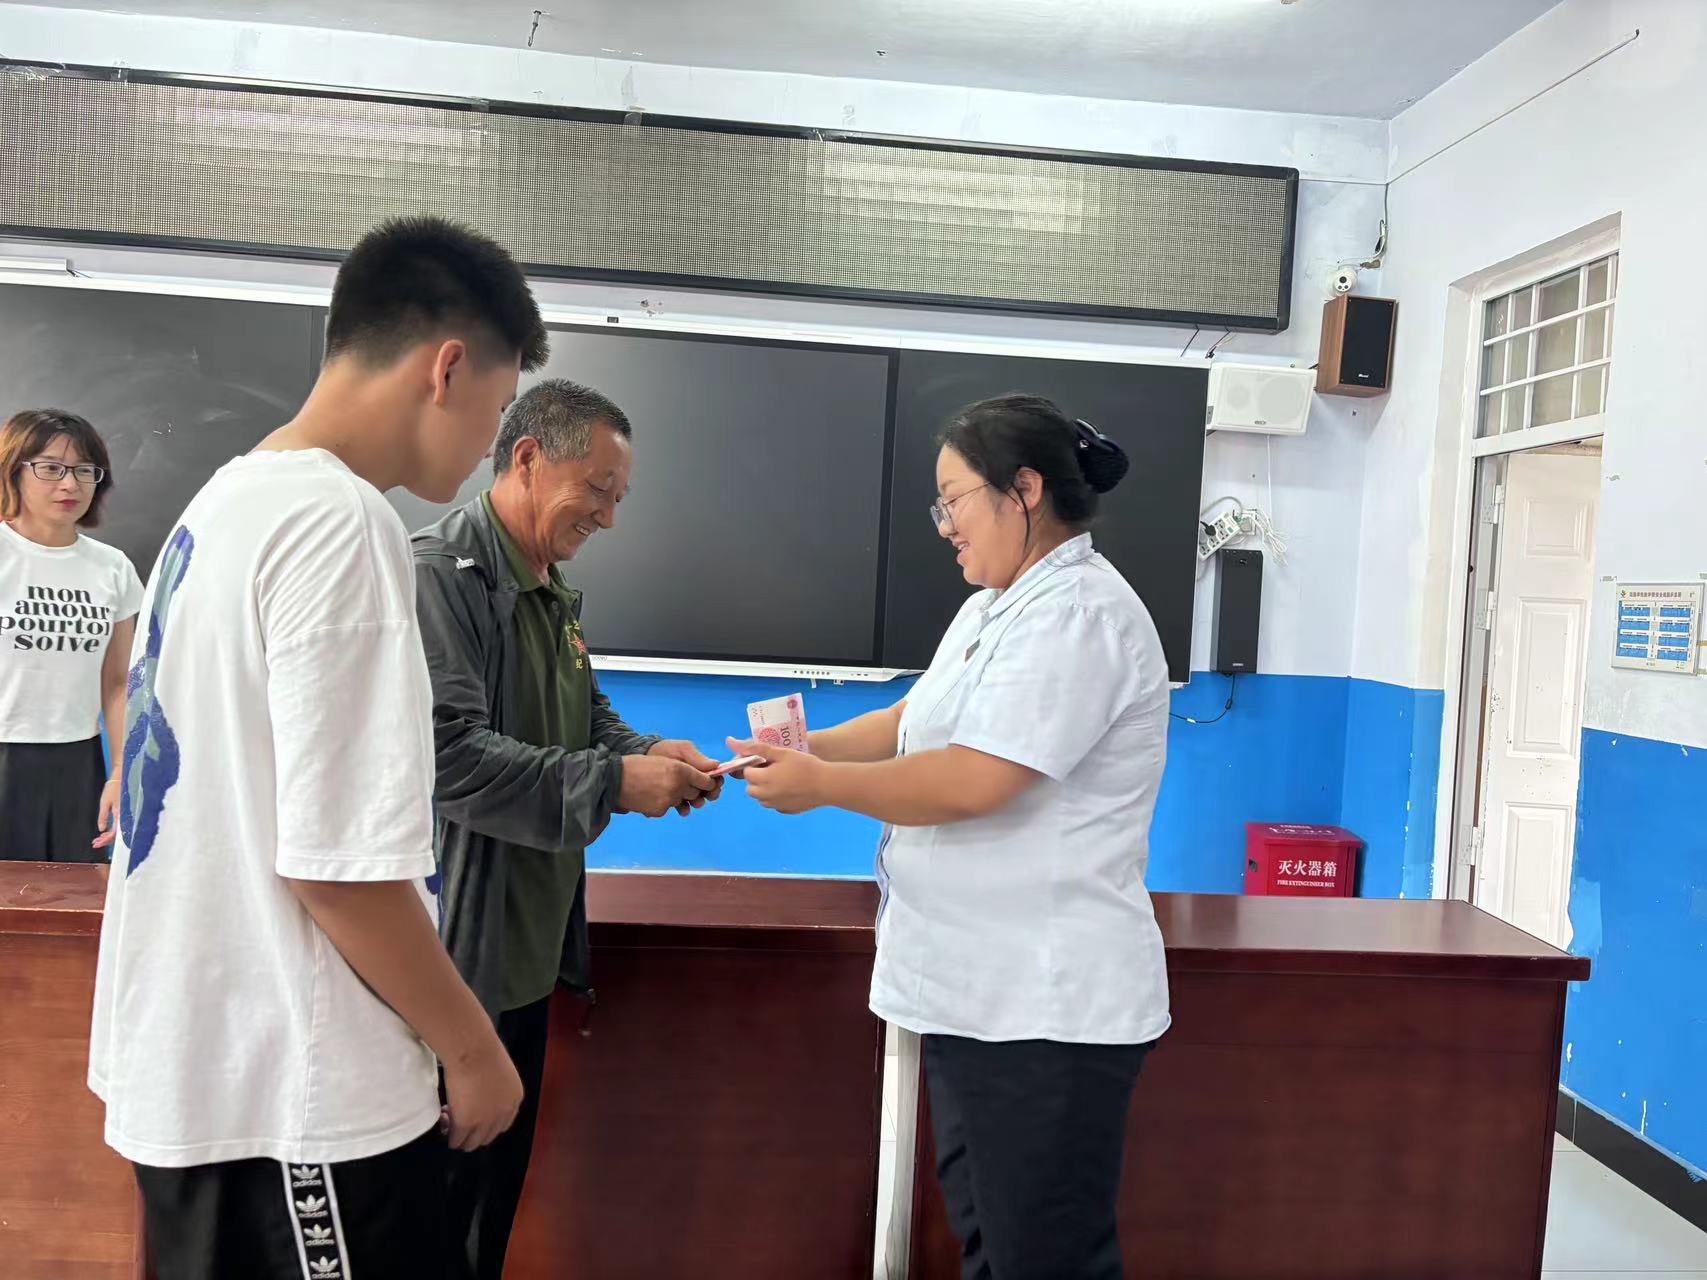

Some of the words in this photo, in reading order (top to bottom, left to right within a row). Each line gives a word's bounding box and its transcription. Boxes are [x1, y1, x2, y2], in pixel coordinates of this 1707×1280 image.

[28, 586, 92, 604] mon
[15, 600, 110, 620] amour
[780, 726, 791, 746] 100
[1278, 860, 1337, 877] 灭火器箱
[292, 1179, 322, 1187] adidas
[312, 1271, 341, 1279] adidas
